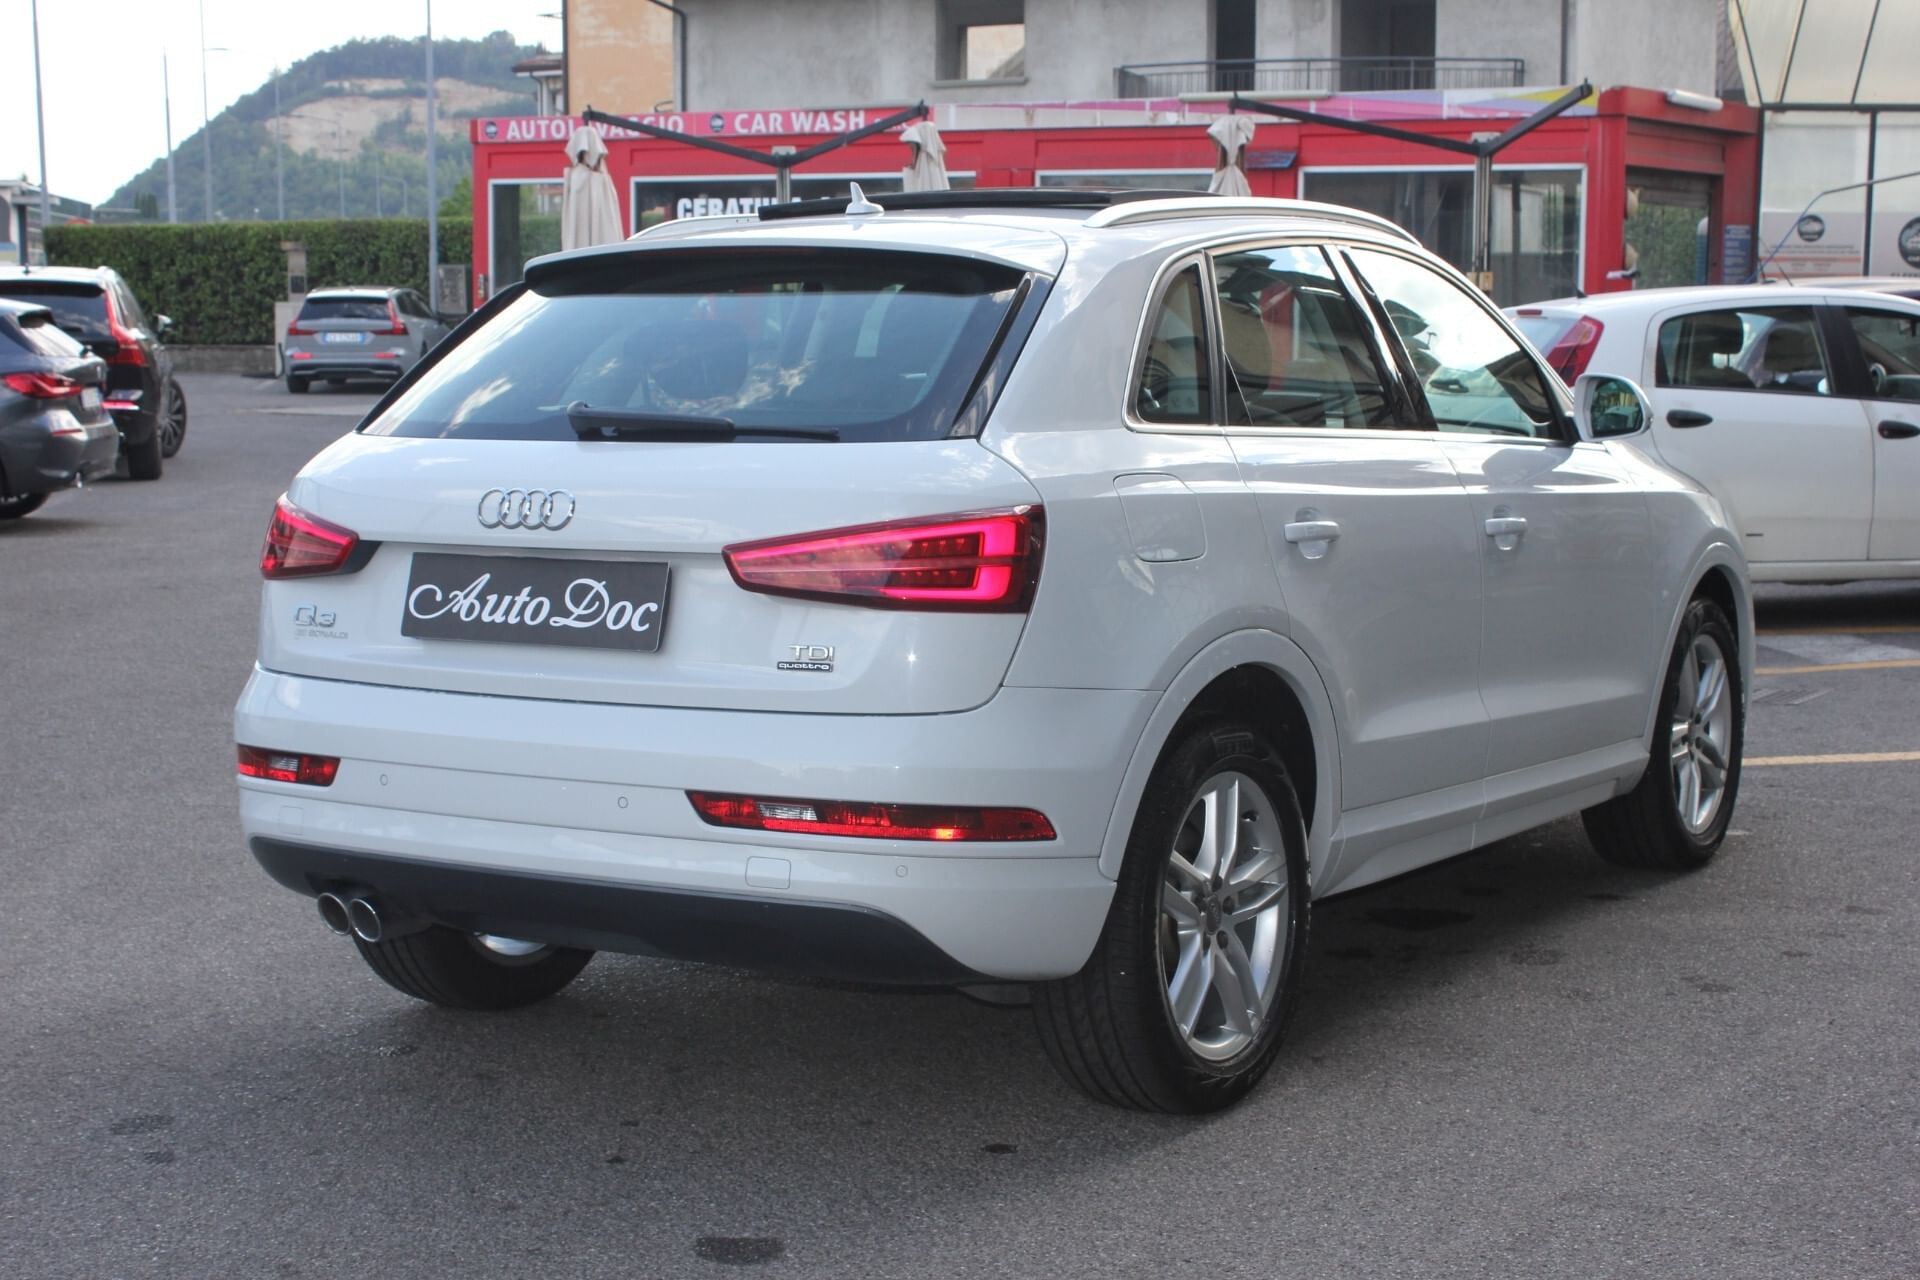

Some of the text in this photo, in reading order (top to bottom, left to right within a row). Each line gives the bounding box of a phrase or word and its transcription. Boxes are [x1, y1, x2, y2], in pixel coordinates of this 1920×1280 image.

[735, 112, 784, 134] CAR
[790, 110, 866, 133] WASH
[408, 573, 659, 632] Auto Doc
[295, 604, 337, 627] Q3
[788, 645, 834, 661] TDI
[778, 662, 831, 671] quattro
